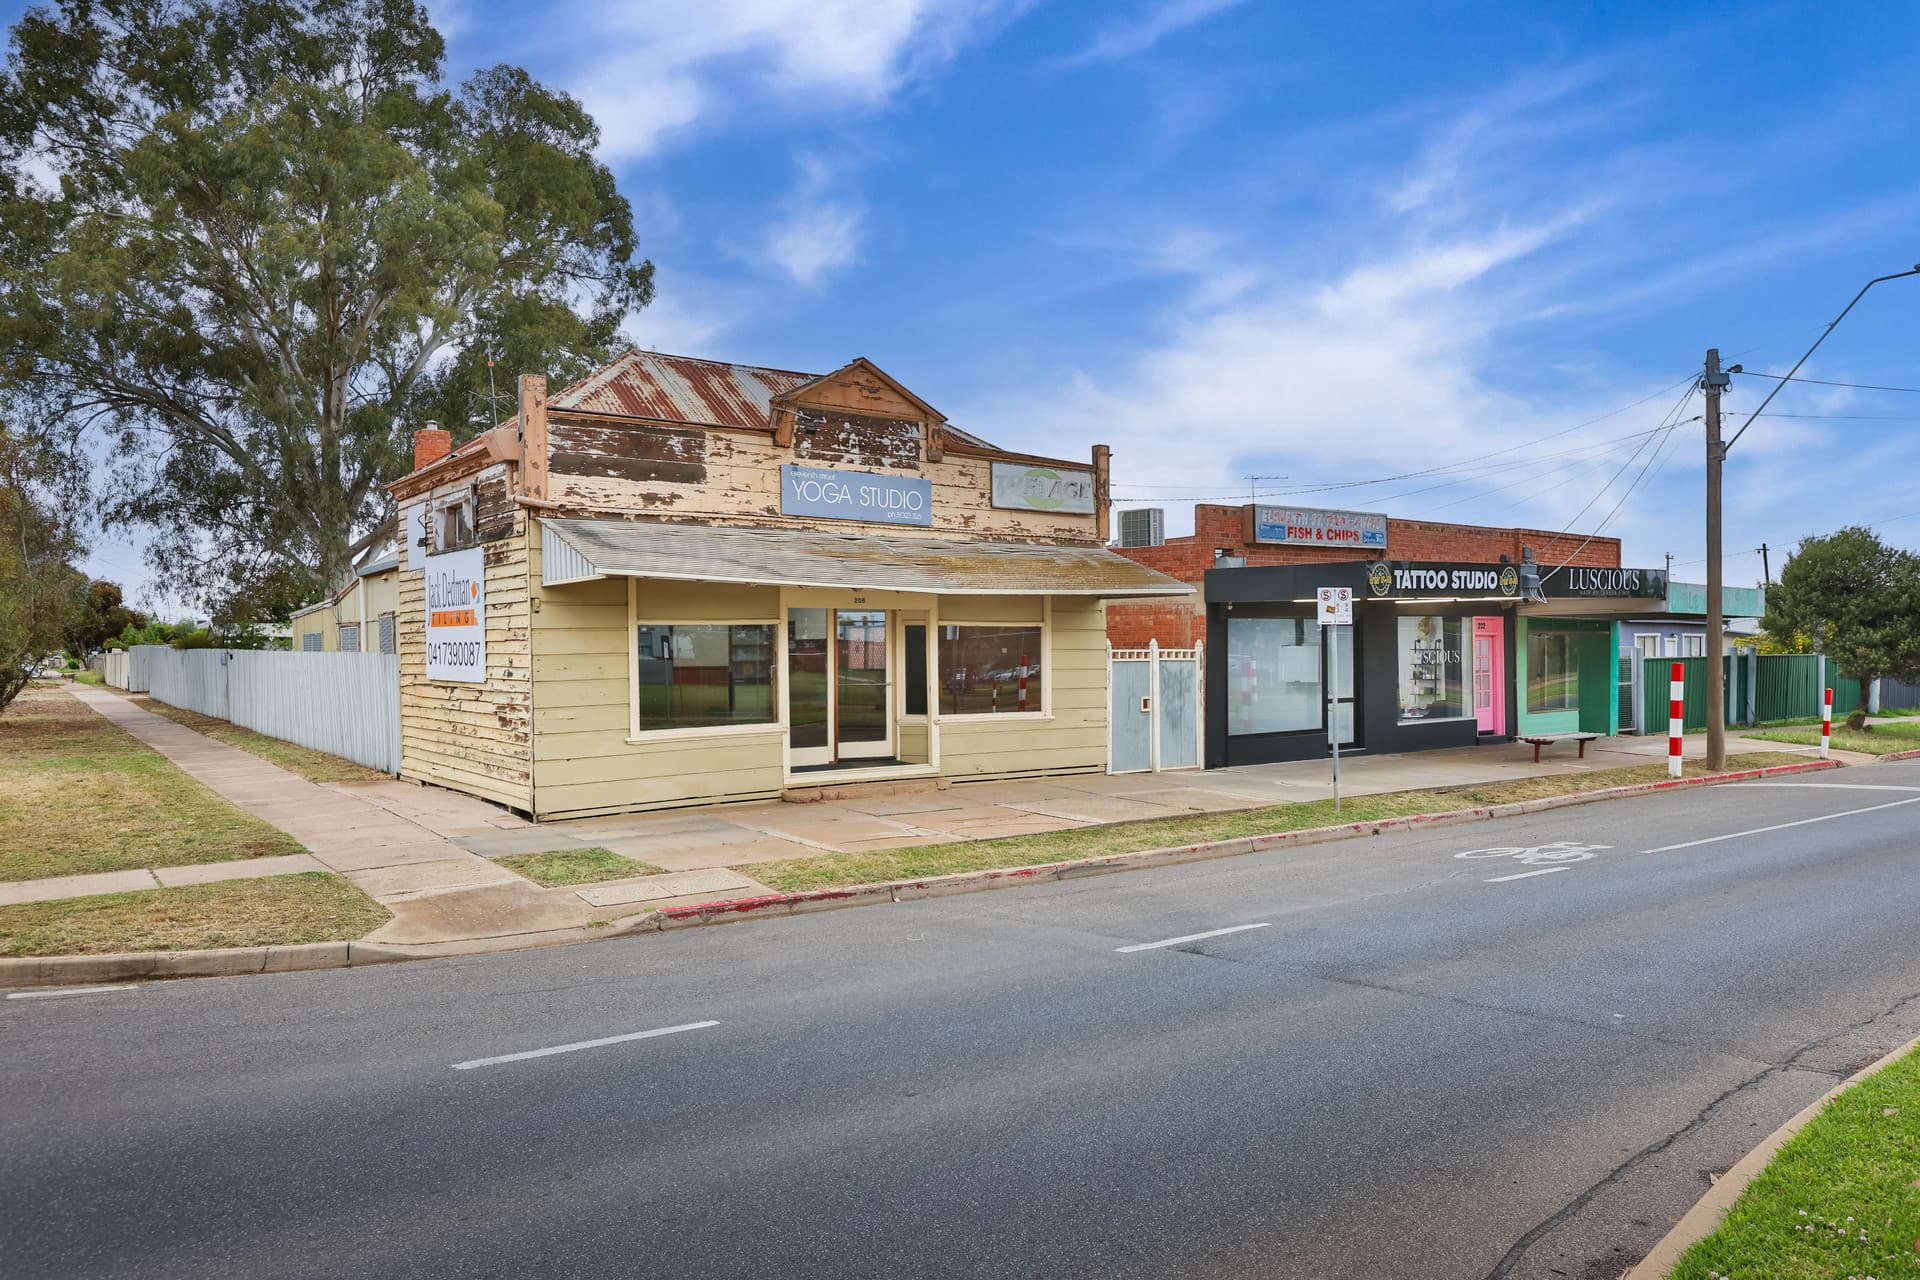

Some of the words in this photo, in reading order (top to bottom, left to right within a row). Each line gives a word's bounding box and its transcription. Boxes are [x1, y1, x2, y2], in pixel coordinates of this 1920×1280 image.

[791, 479, 853, 505] YOGA
[859, 486, 923, 511] STUDIO
[1287, 526, 1313, 540] FISH
[1316, 528, 1323, 540] &
[1326, 529, 1360, 542] CHIPS
[1394, 569, 1448, 590] TATTOO
[1451, 570, 1498, 590] STUDIO
[1569, 568, 1640, 591] LUSCIOUS
[432, 612, 470, 624] TILING
[428, 642, 481, 667] 0417390087
[1421, 650, 1460, 664] SCIOUS
